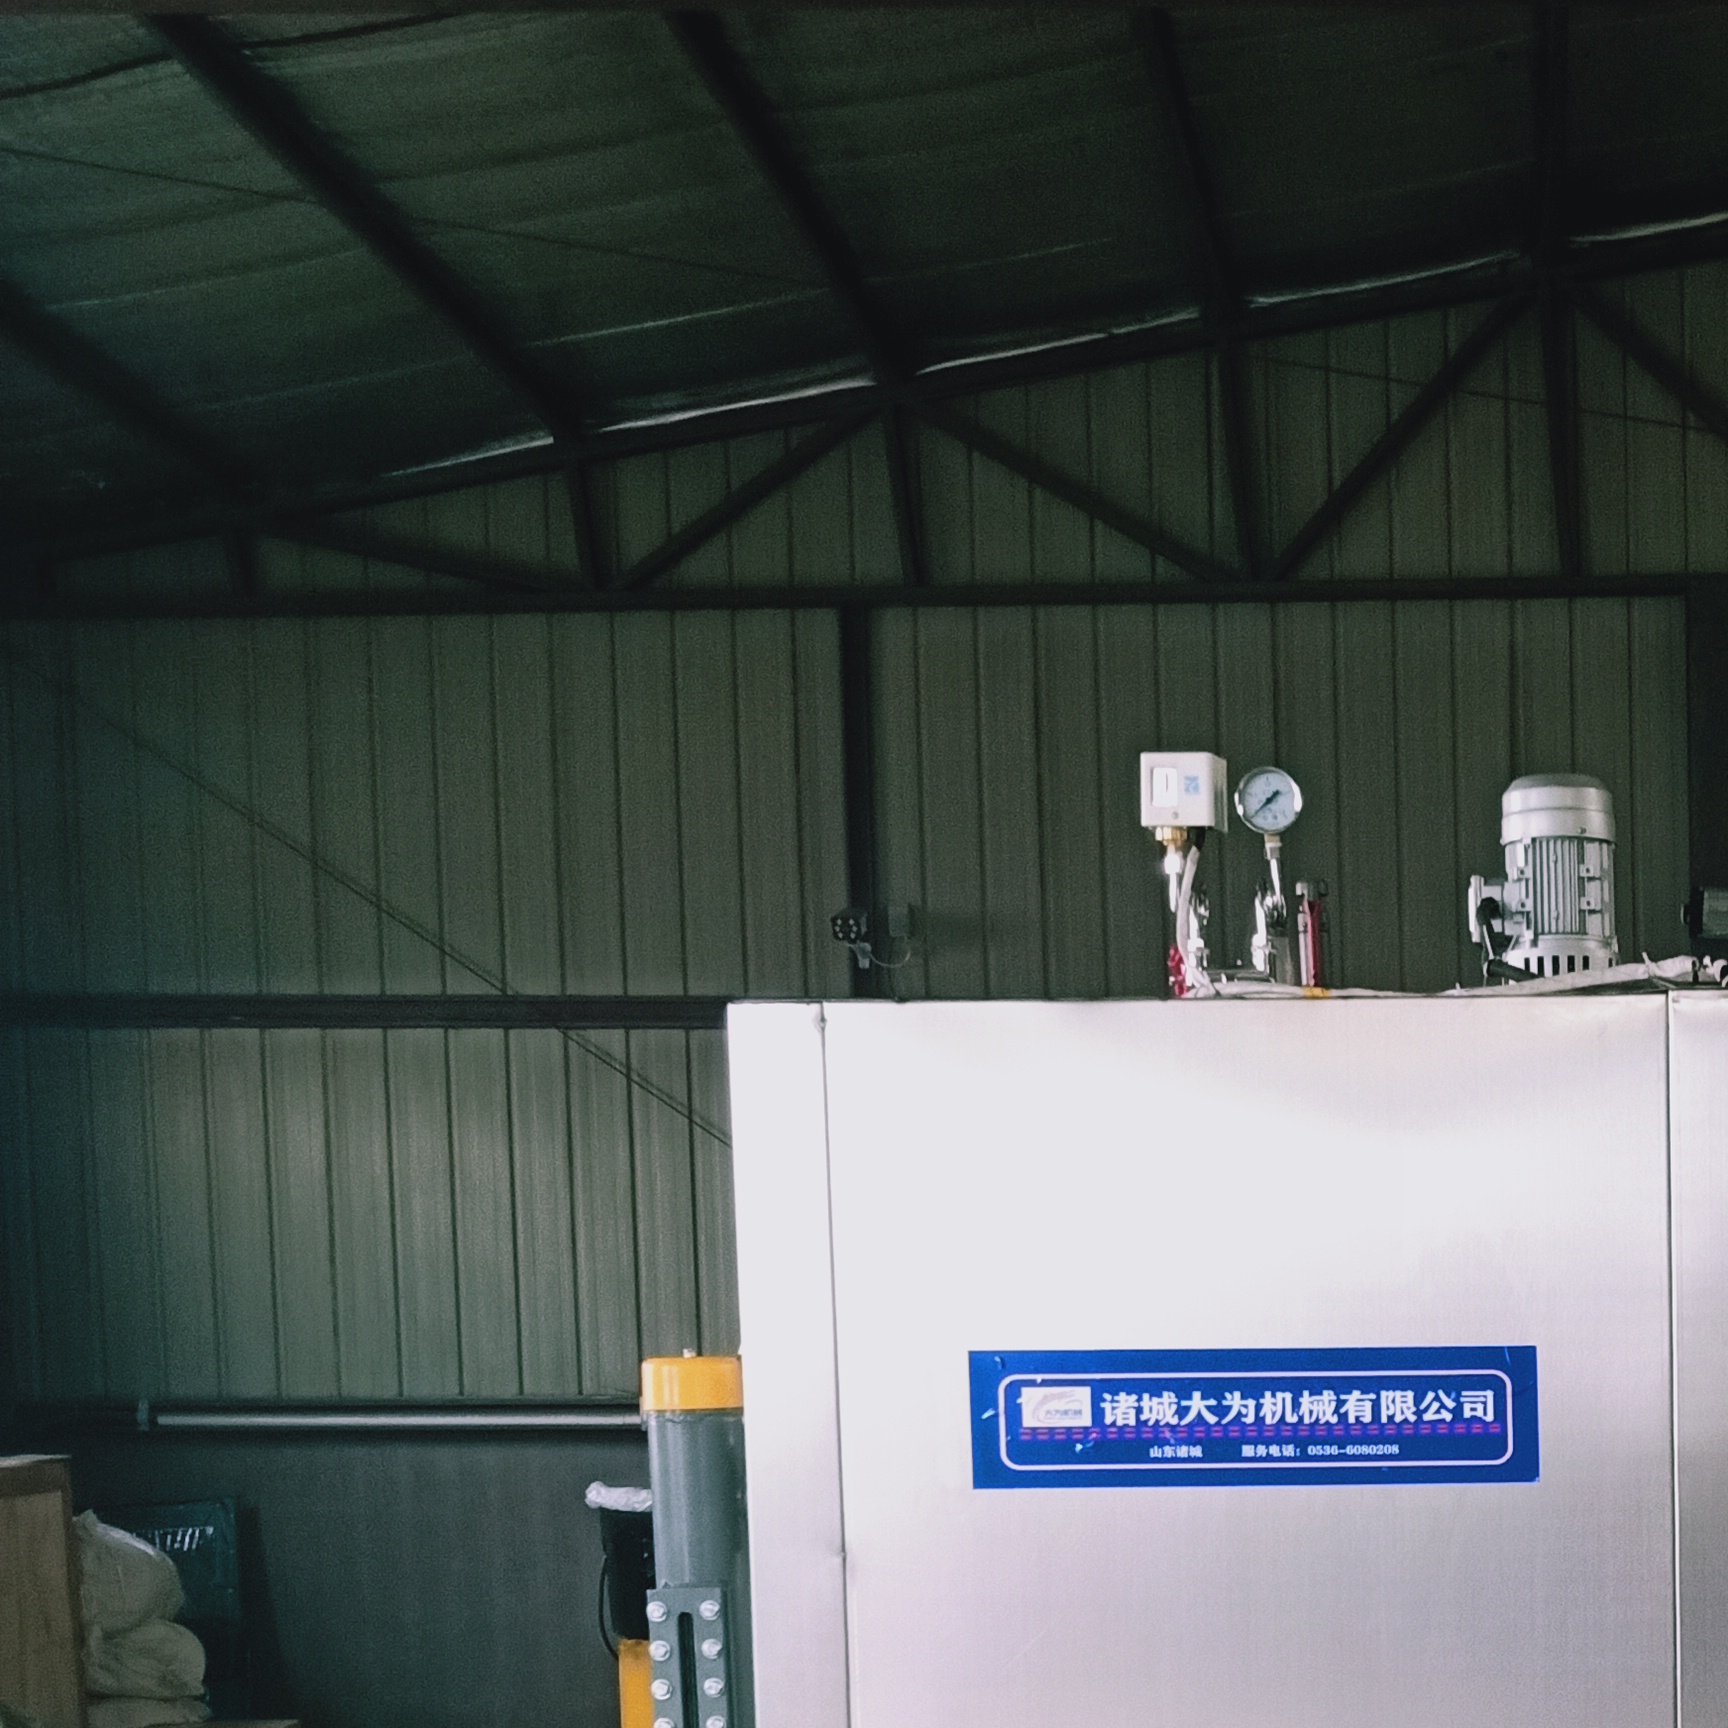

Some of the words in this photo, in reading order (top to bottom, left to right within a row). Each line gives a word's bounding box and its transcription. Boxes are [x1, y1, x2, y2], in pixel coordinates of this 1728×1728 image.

[1100, 1389, 1495, 1426] 诸城大为机械有限公司
[1149, 1445, 1203, 1458] 山东诸城
